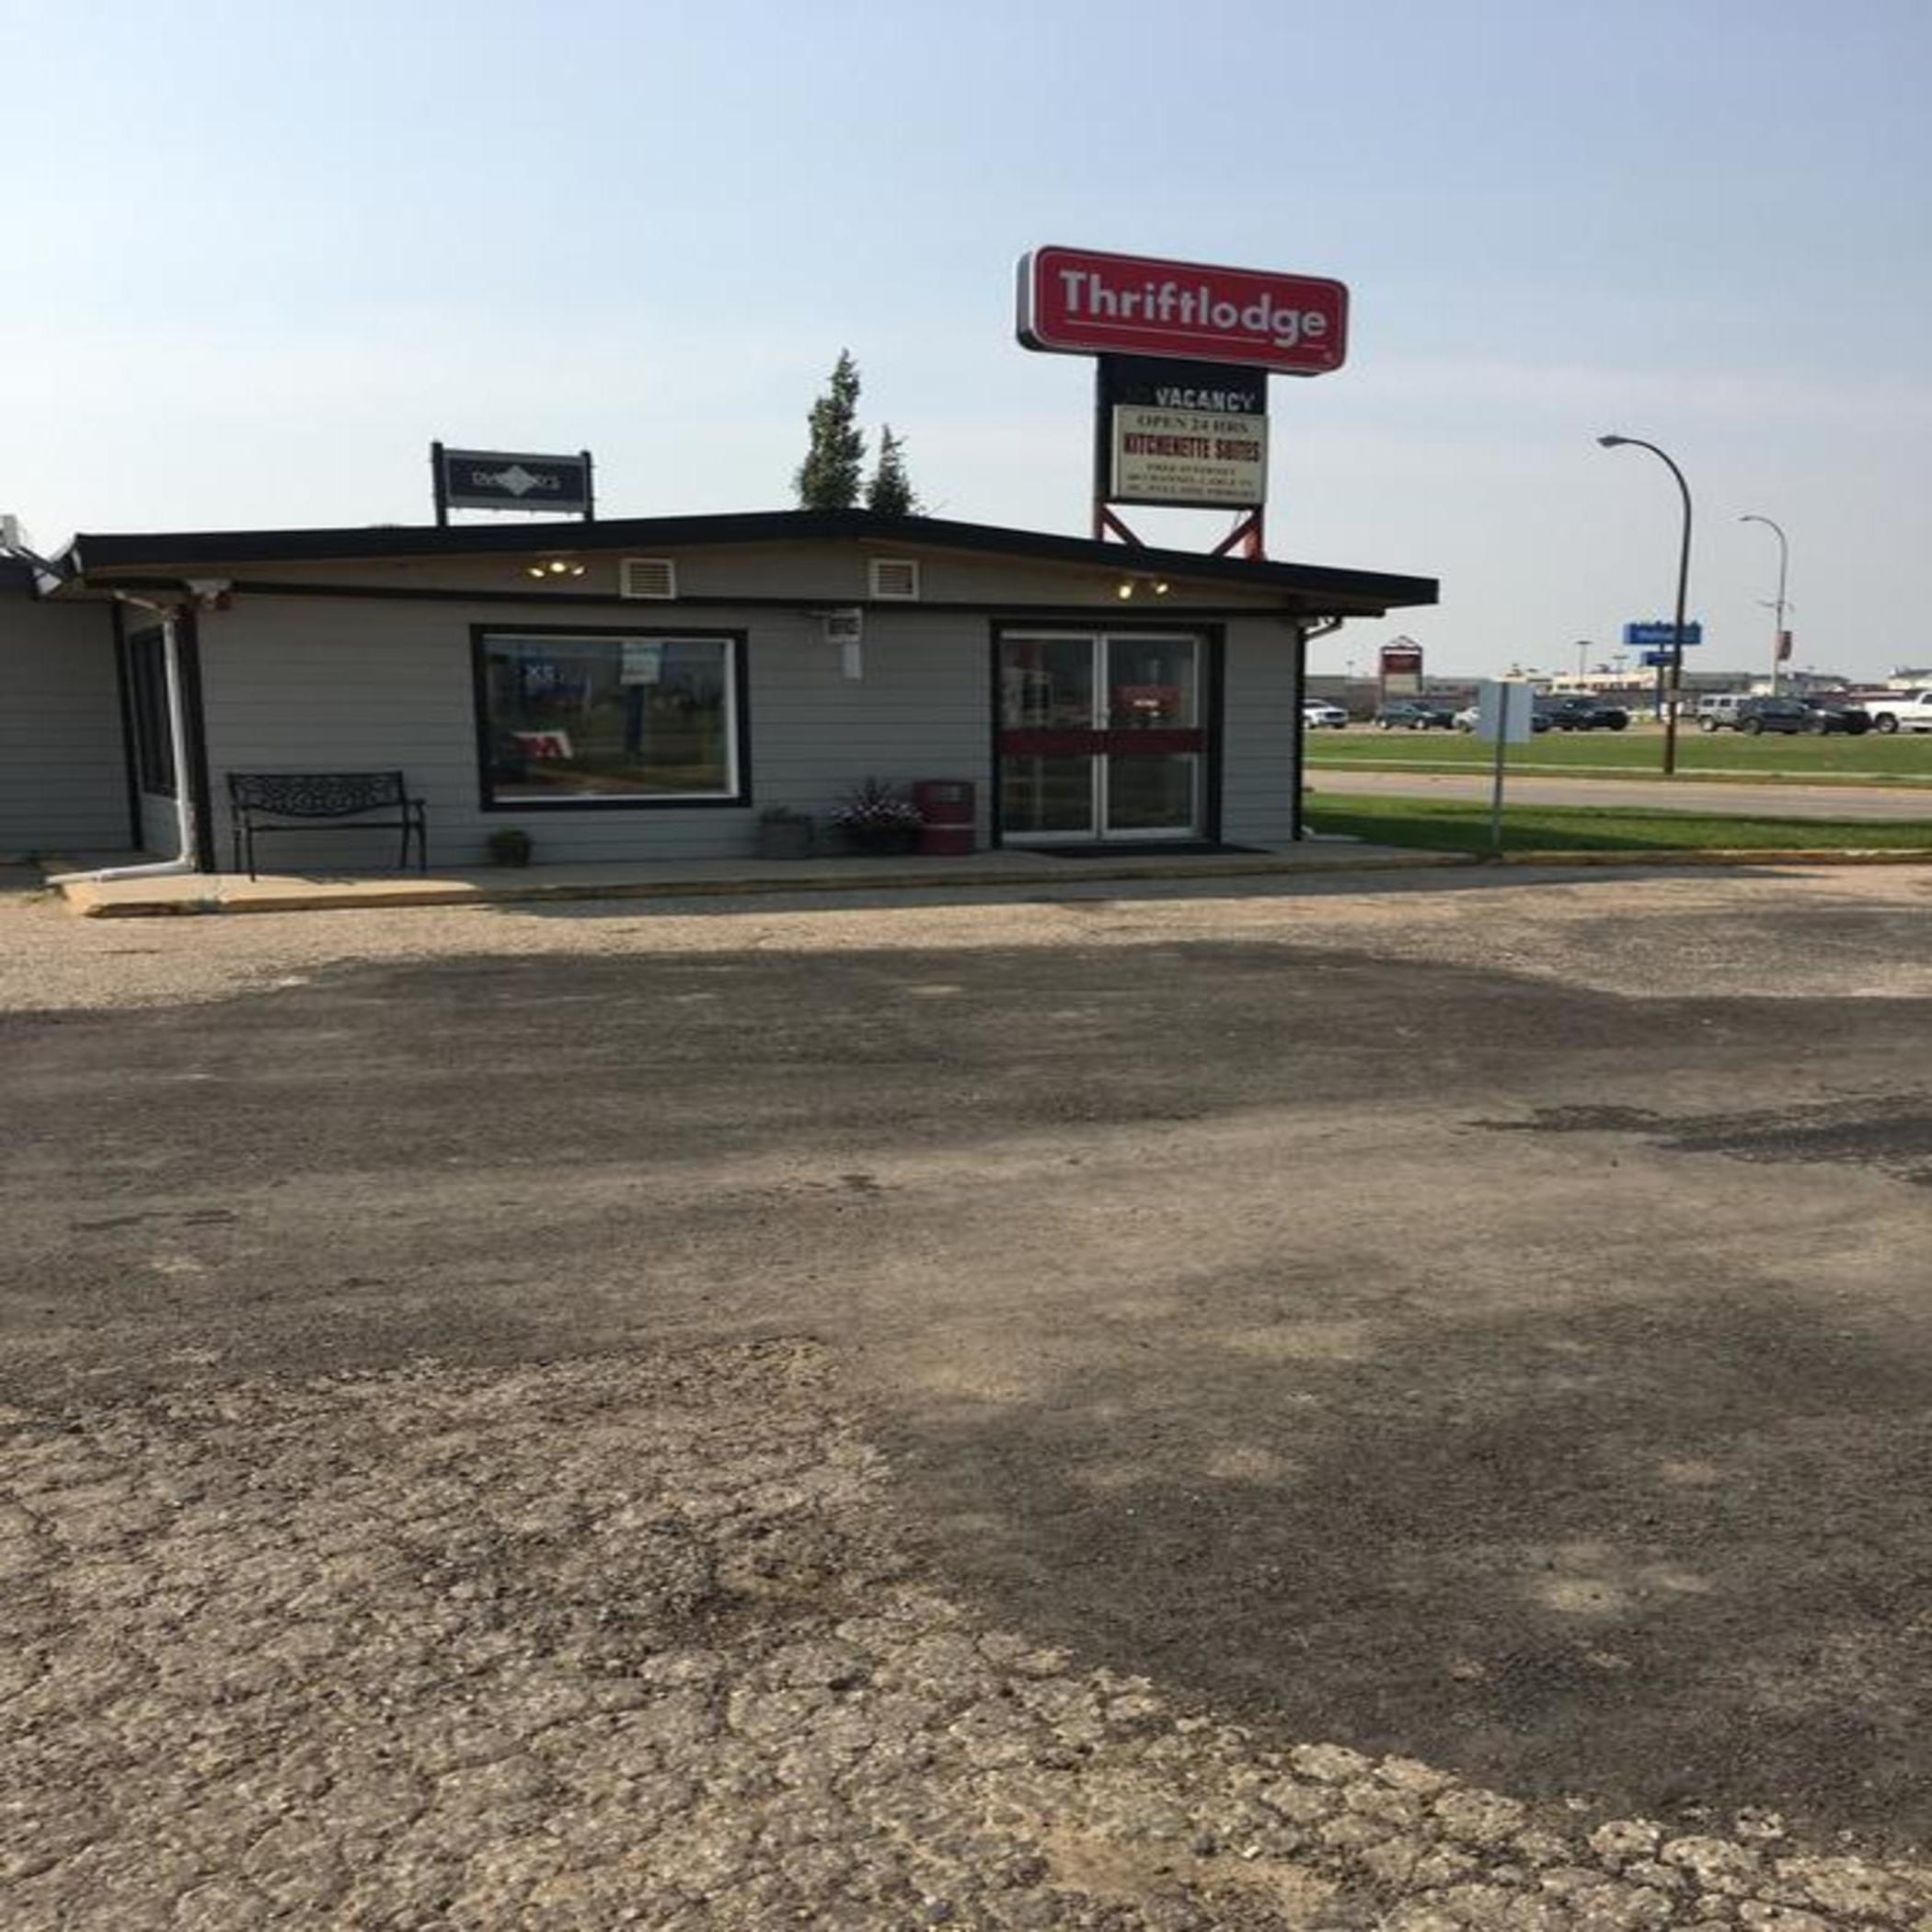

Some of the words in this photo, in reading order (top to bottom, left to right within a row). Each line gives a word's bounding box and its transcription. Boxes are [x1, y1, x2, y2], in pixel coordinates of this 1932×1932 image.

[1059, 270, 1328, 349] Thriftlodge
[1156, 386, 1256, 411] VACANCY
[1136, 414, 1187, 429] OPEN
[1192, 418, 1209, 432] 24
[1123, 432, 1211, 459] KITCHENETTE
[1215, 438, 1260, 462] SUITES
